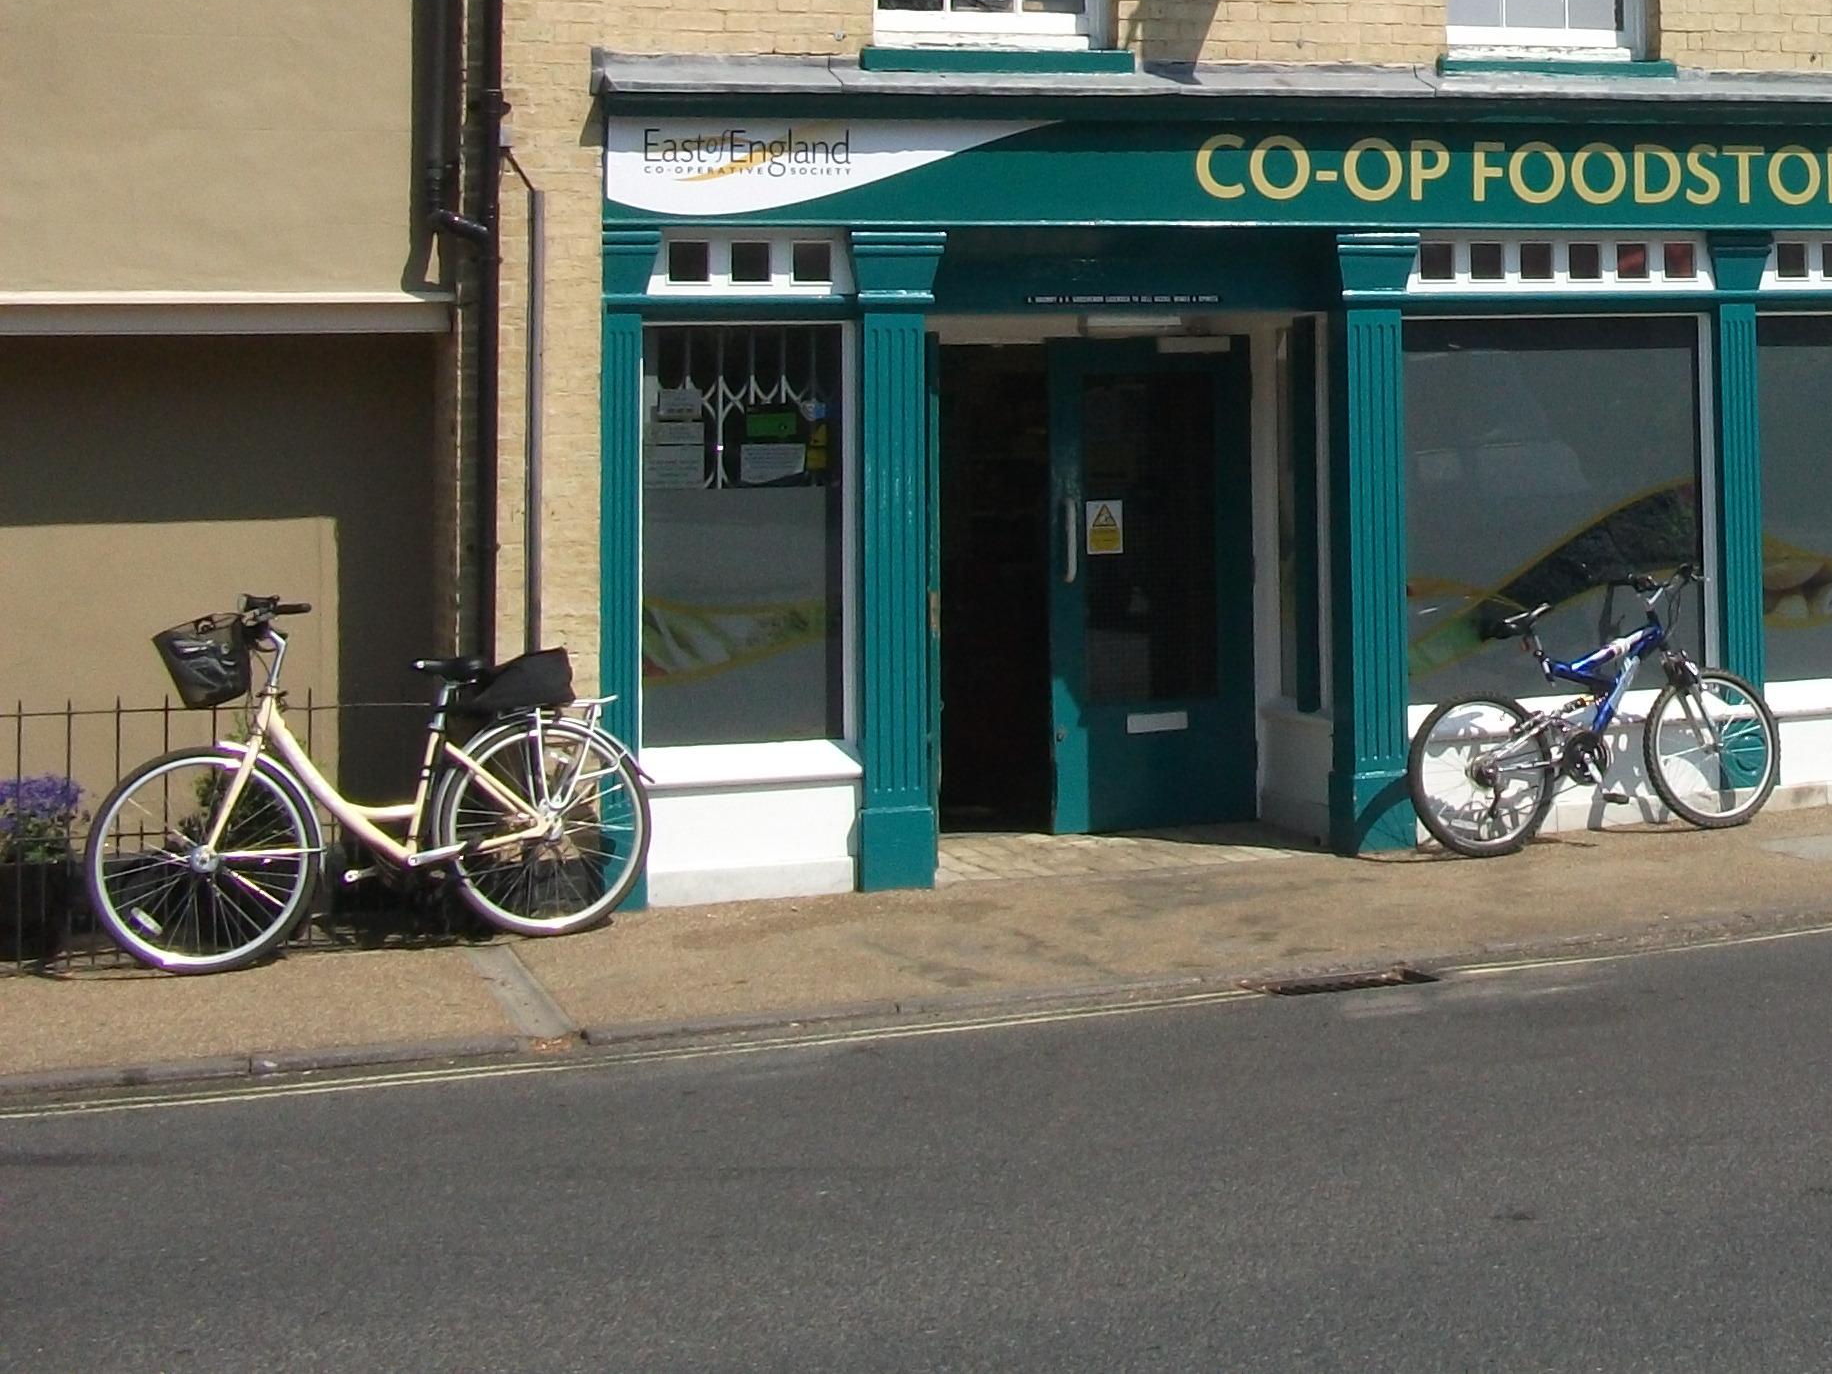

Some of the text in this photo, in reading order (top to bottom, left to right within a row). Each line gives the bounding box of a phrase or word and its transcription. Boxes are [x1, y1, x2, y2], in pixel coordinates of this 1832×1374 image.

[643, 128, 851, 177] East of England
[643, 166, 851, 176] CO-OPERATIVE SOCIETY
[1195, 133, 1450, 202] CO-OP
